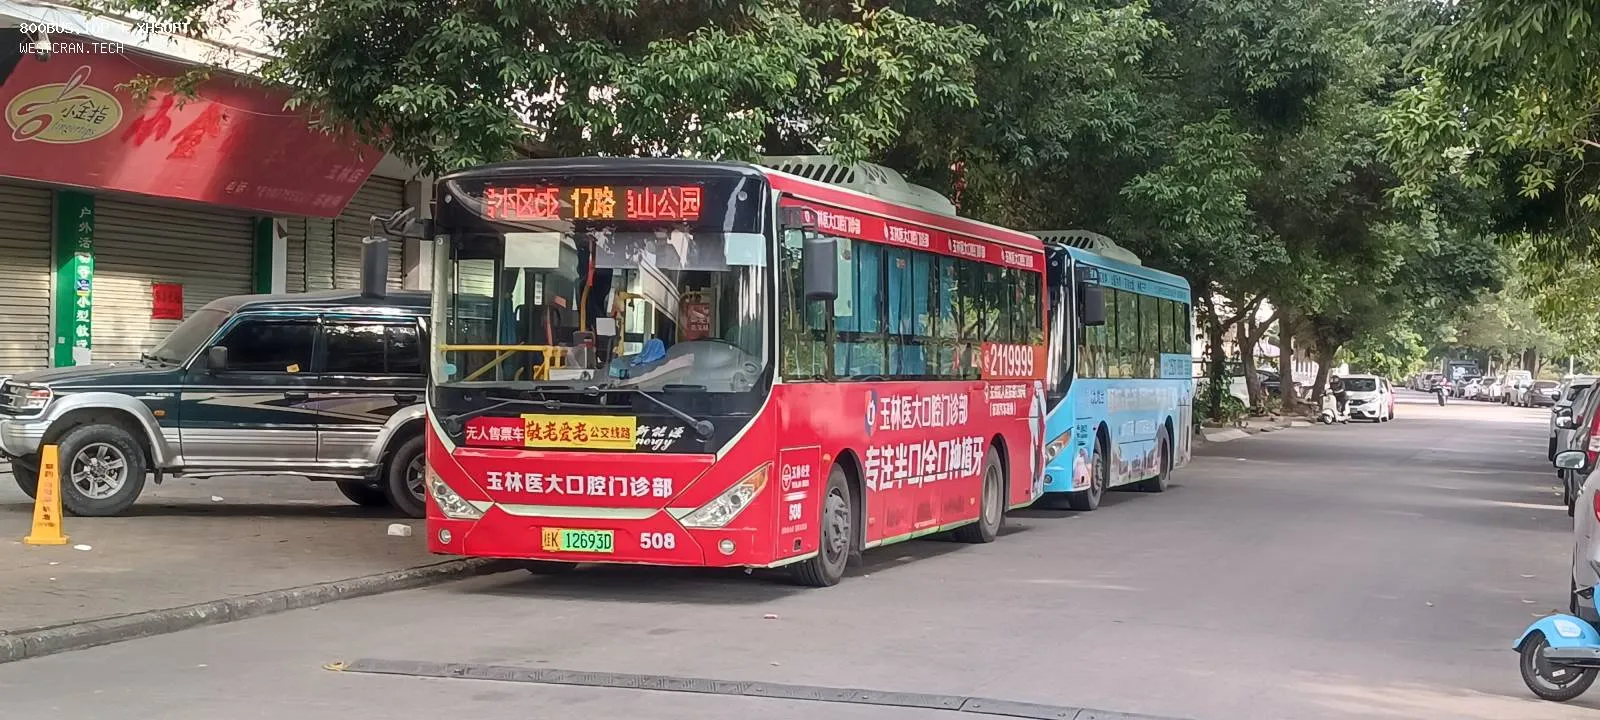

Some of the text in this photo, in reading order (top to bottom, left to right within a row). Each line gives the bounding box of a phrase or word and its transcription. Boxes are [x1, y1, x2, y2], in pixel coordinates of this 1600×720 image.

[570, 186, 616, 218] 17路
[990, 343, 1034, 377] 2119999
[879, 393, 969, 431] 玉林医大口腔门诊部
[466, 425, 525, 442] 无人售票车
[636, 438, 675, 451] nergy
[486, 471, 673, 499] 玉林医大口腔门诊部
[566, 532, 612, 550] 12693D
[639, 532, 676, 549] 508
